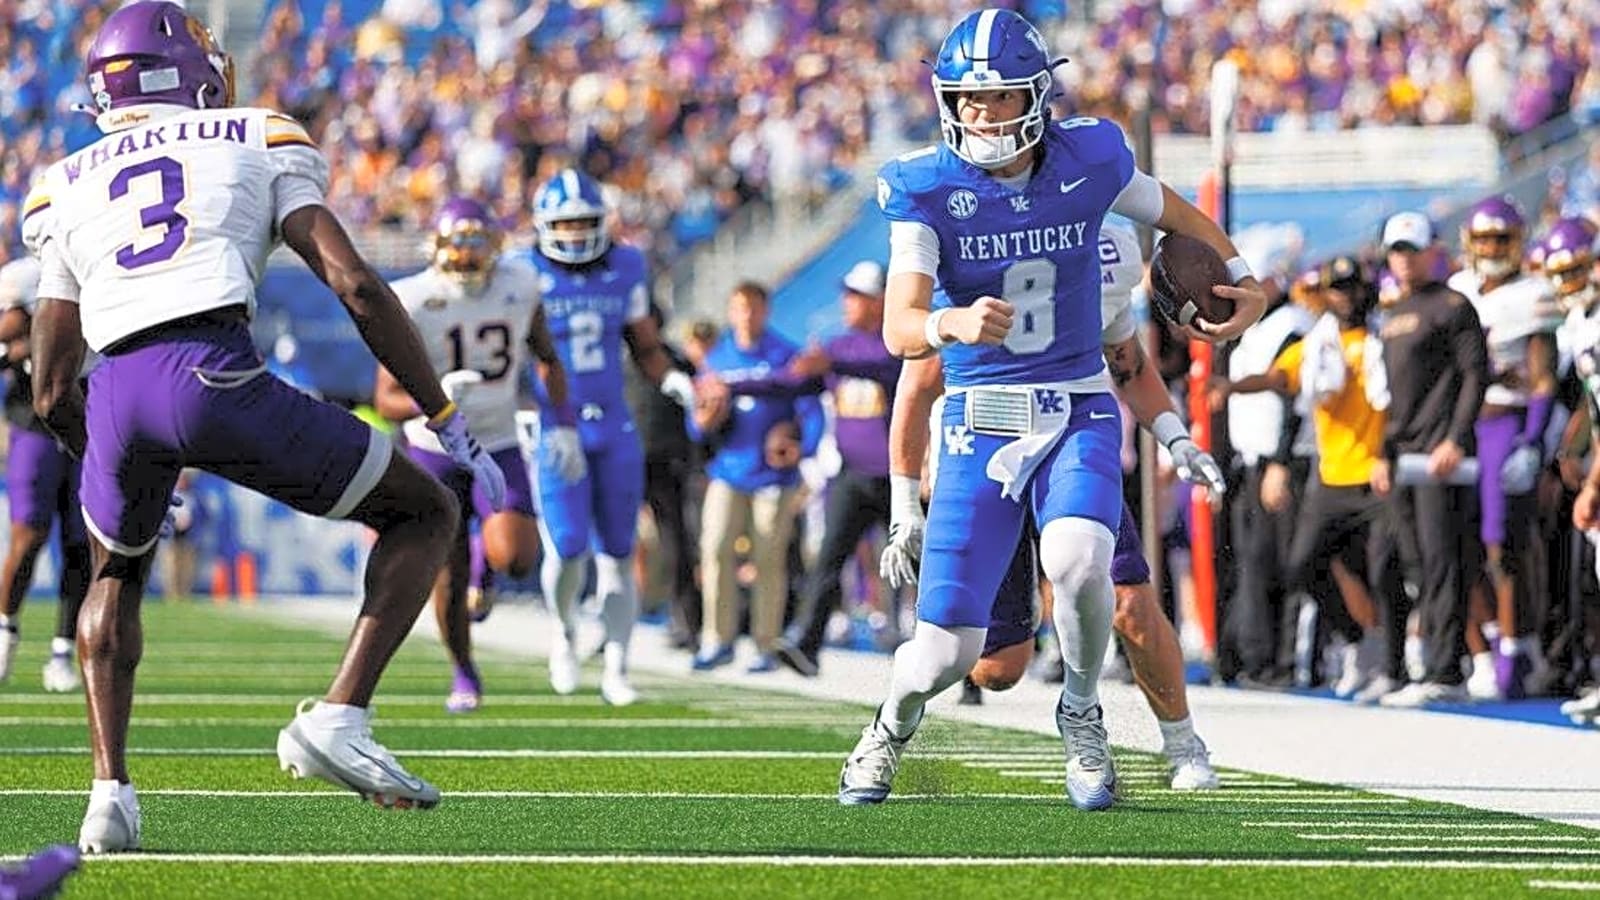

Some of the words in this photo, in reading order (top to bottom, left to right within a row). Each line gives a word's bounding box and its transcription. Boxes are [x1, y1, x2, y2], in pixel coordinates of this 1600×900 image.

[63, 118, 249, 185] WHARTON
[108, 155, 190, 270] 3
[950, 192, 977, 216] SEC
[959, 221, 1087, 261] KENTUCKY
[1002, 257, 1057, 355] 8
[447, 322, 512, 382] 13
[568, 311, 605, 373] 2
